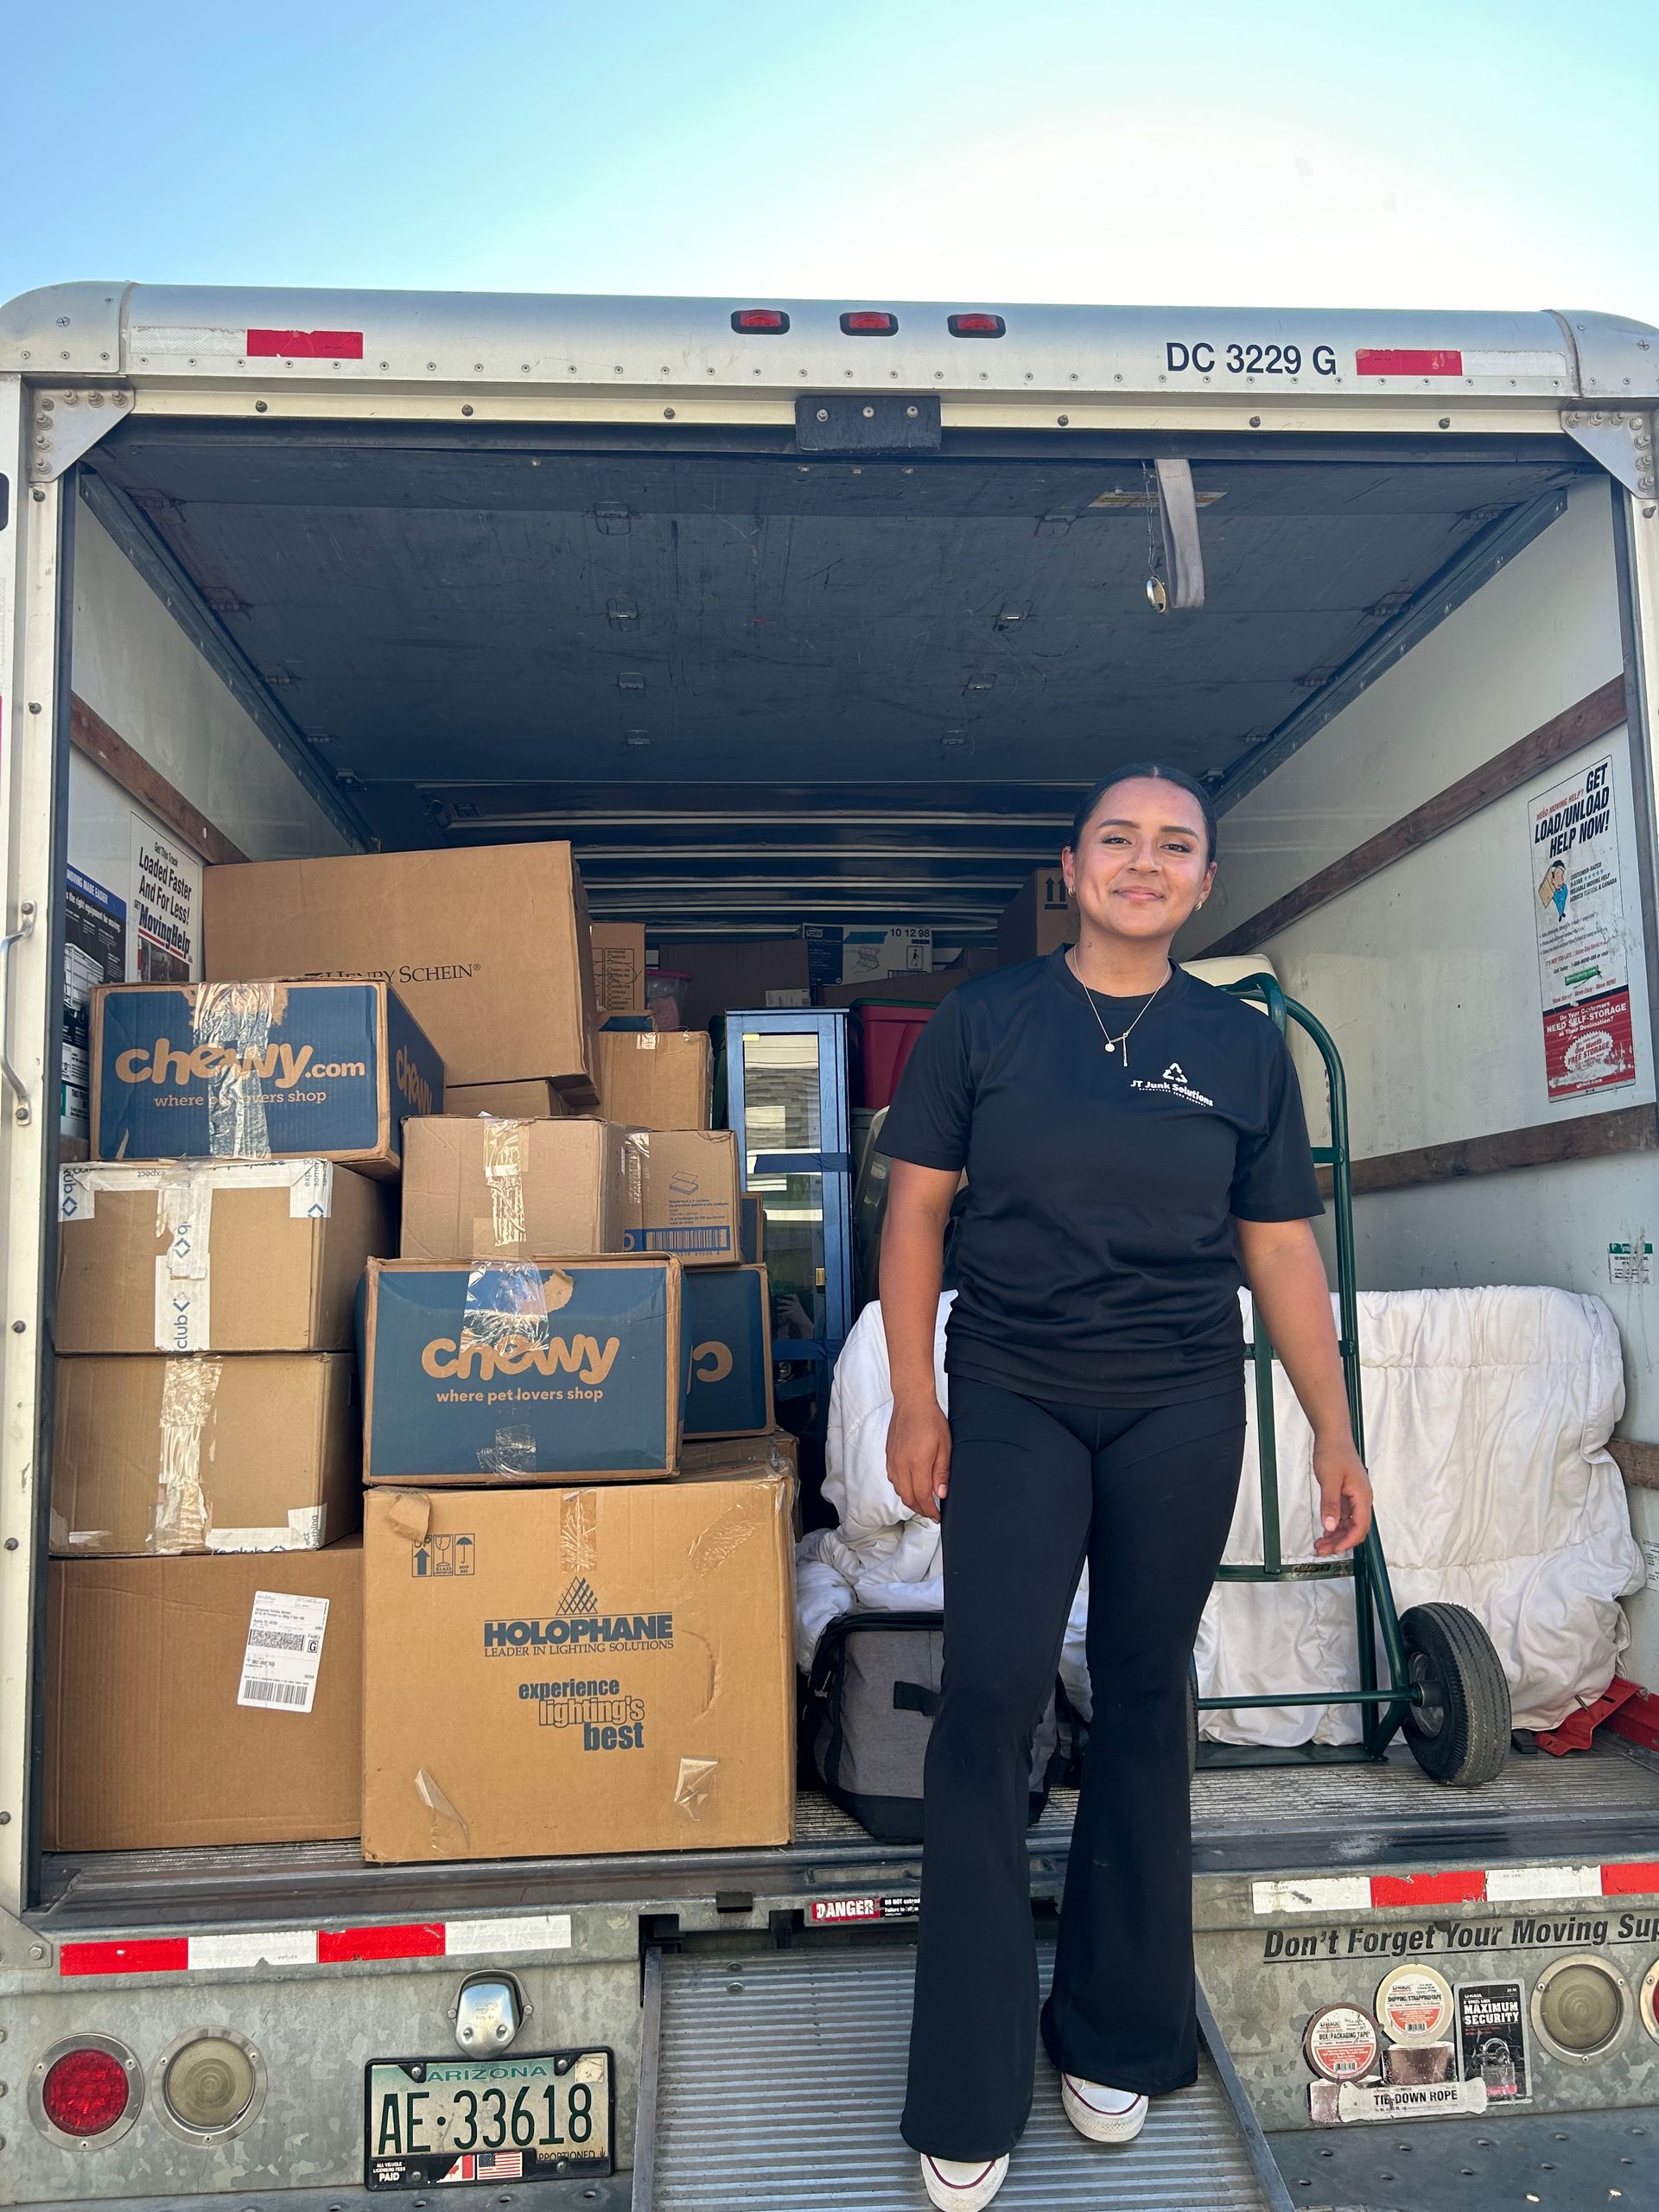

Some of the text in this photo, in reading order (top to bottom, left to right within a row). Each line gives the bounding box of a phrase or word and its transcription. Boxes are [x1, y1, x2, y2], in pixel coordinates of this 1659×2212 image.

[1166, 342, 1338, 376] DC 3229 G
[1586, 762, 1608, 793] GET
[1535, 786, 1610, 844] LOAD/UNLOAD
[1549, 810, 1611, 859] HELP NOW!
[139, 847, 192, 901] Loaded Faster
[139, 874, 190, 925] And For Less!
[890, 928, 902, 938] 10
[905, 928, 916, 938] 12
[918, 929, 931, 938] 98
[1547, 1002, 1627, 1033] NEED SELF-STORAGE
[1568, 1053, 1582, 1065] FREE
[1583, 1040, 1610, 1058] STORAGE
[154, 1094, 204, 1107] where
[288, 1090, 327, 1105] shop
[1144, 1081, 1171, 1090] Junk
[1172, 1084, 1214, 1107] Solutions
[174, 1314, 188, 1349] club
[422, 1333, 620, 1385] chewy
[436, 1387, 603, 1405] where pet lovers shop
[484, 1615, 673, 1647] HOLOPHANE
[485, 1640, 674, 1657] LEADER IN LIGHTING SOLUTIONS
[518, 1679, 620, 1700] experience
[539, 1695, 645, 1728] lighting's
[583, 1722, 645, 1751] best
[817, 1899, 874, 1918] DANGER
[1264, 1929, 1339, 1958] Don't
[1348, 1926, 1435, 1957] Forget
[1446, 1922, 1503, 1948] Your
[1511, 1916, 1607, 1945] Moving
[1464, 2002, 1519, 2014] MAXIMUM
[1465, 2012, 1519, 2025] SECURITY
[427, 2066, 548, 2082] ARIZONA
[1430, 2089, 1458, 2101] ROPE
[379, 2172, 400, 2183] PAID
